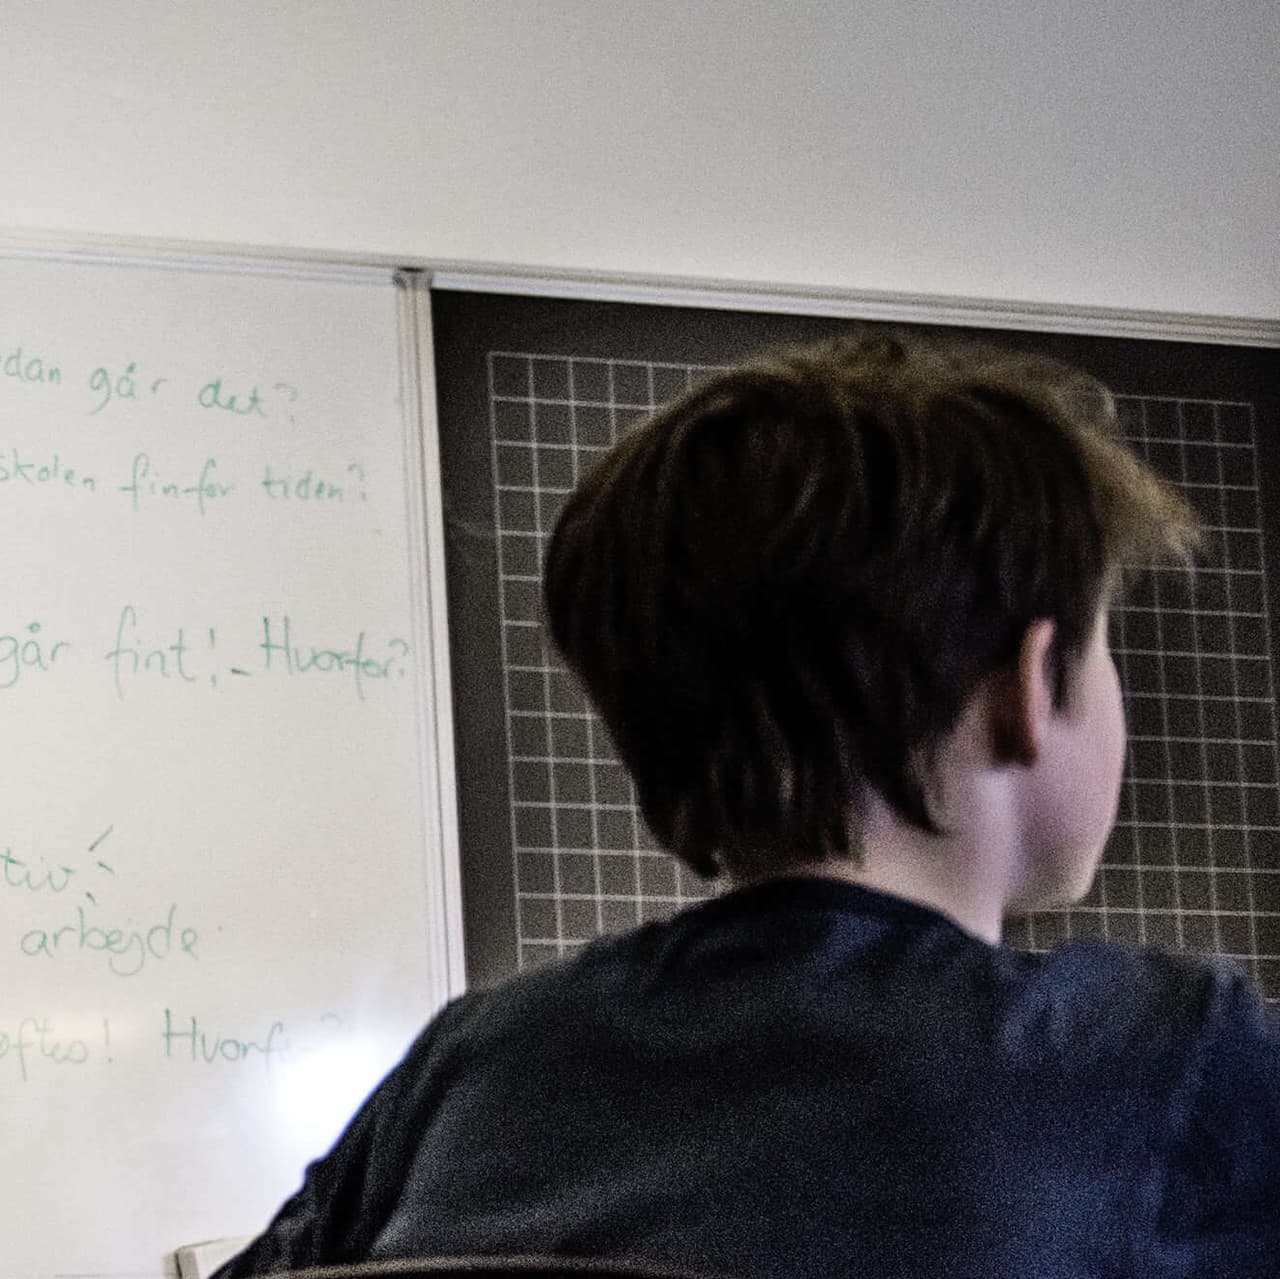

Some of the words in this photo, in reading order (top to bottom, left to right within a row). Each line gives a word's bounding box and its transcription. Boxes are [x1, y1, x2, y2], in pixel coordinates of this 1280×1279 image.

[88, 362, 167, 416] går
[198, 376, 298, 424] det?
[262, 463, 368, 503] tiden?
